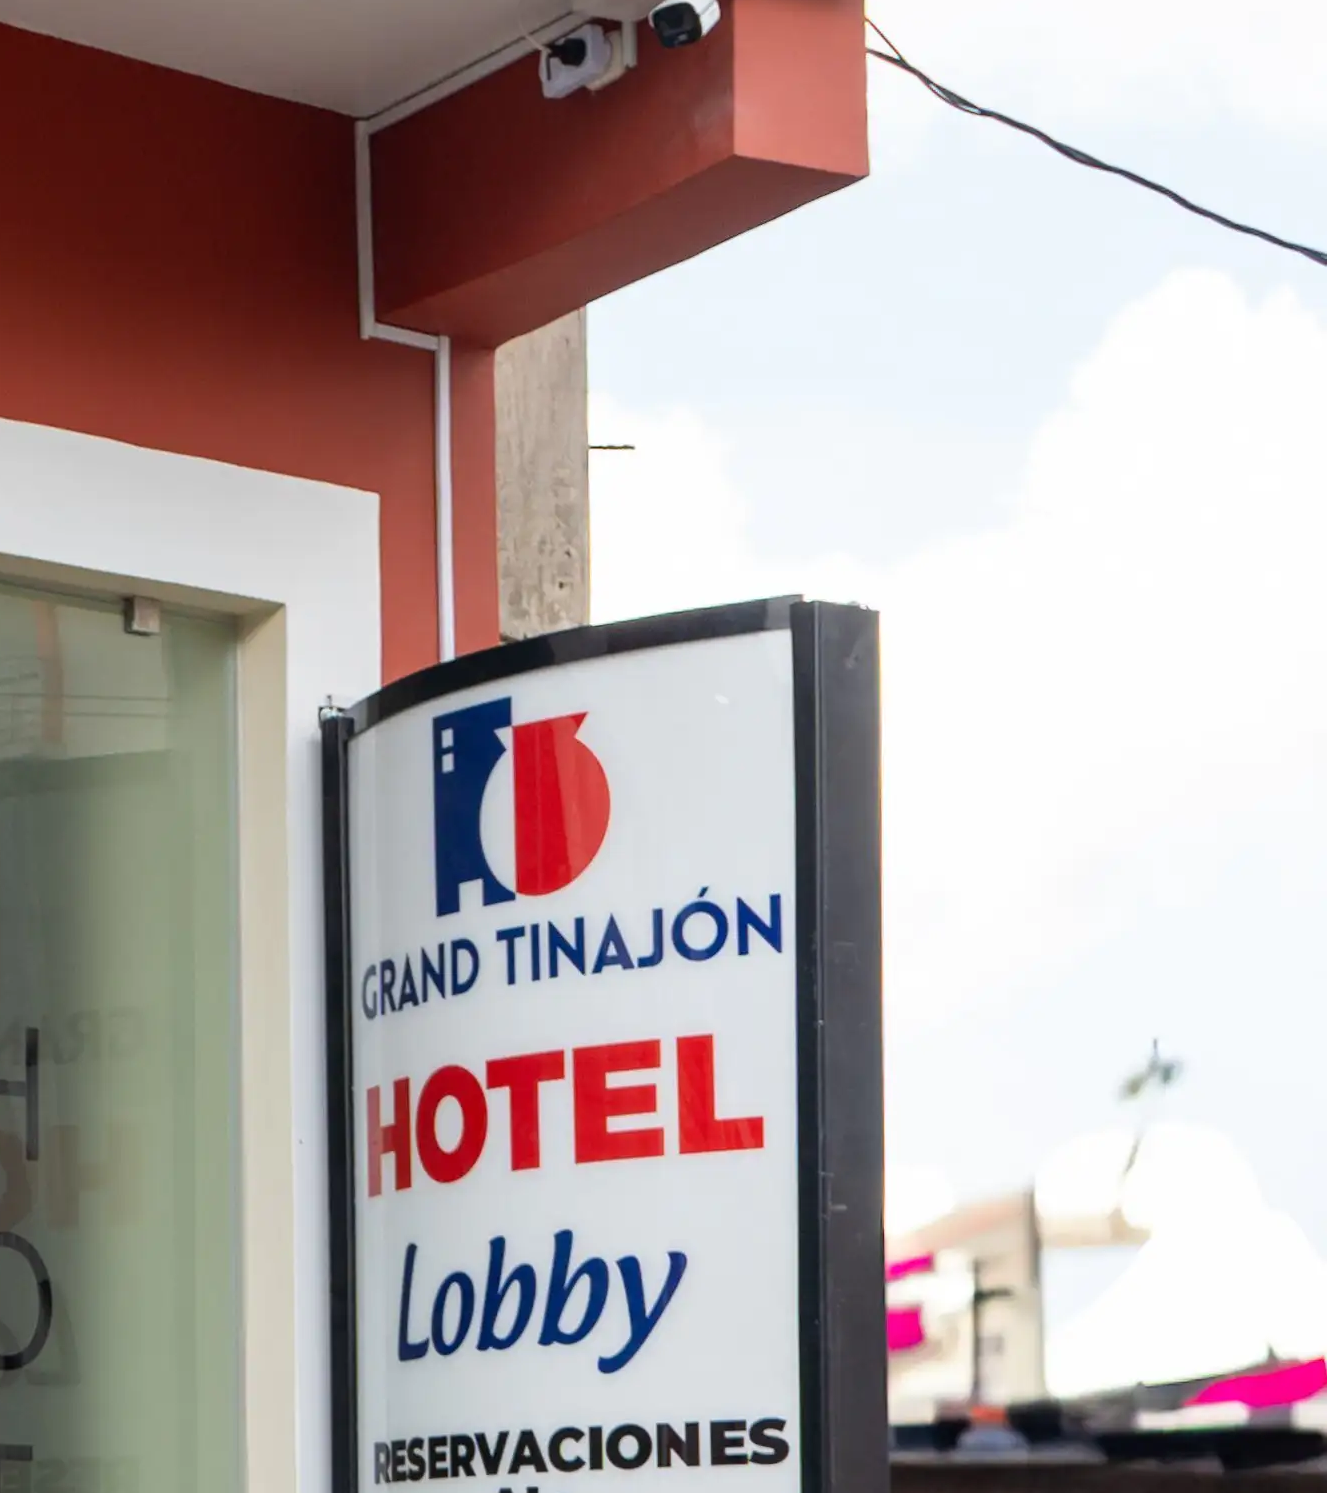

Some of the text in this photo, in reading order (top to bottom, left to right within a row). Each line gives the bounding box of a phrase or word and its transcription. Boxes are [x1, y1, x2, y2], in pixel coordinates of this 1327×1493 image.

[362, 887, 783, 1020] GRAND TINAJÓN
[366, 1034, 764, 1198] HOTEL
[398, 1229, 687, 1374] Lobby
[374, 1418, 789, 1484] RESERVACIONES
